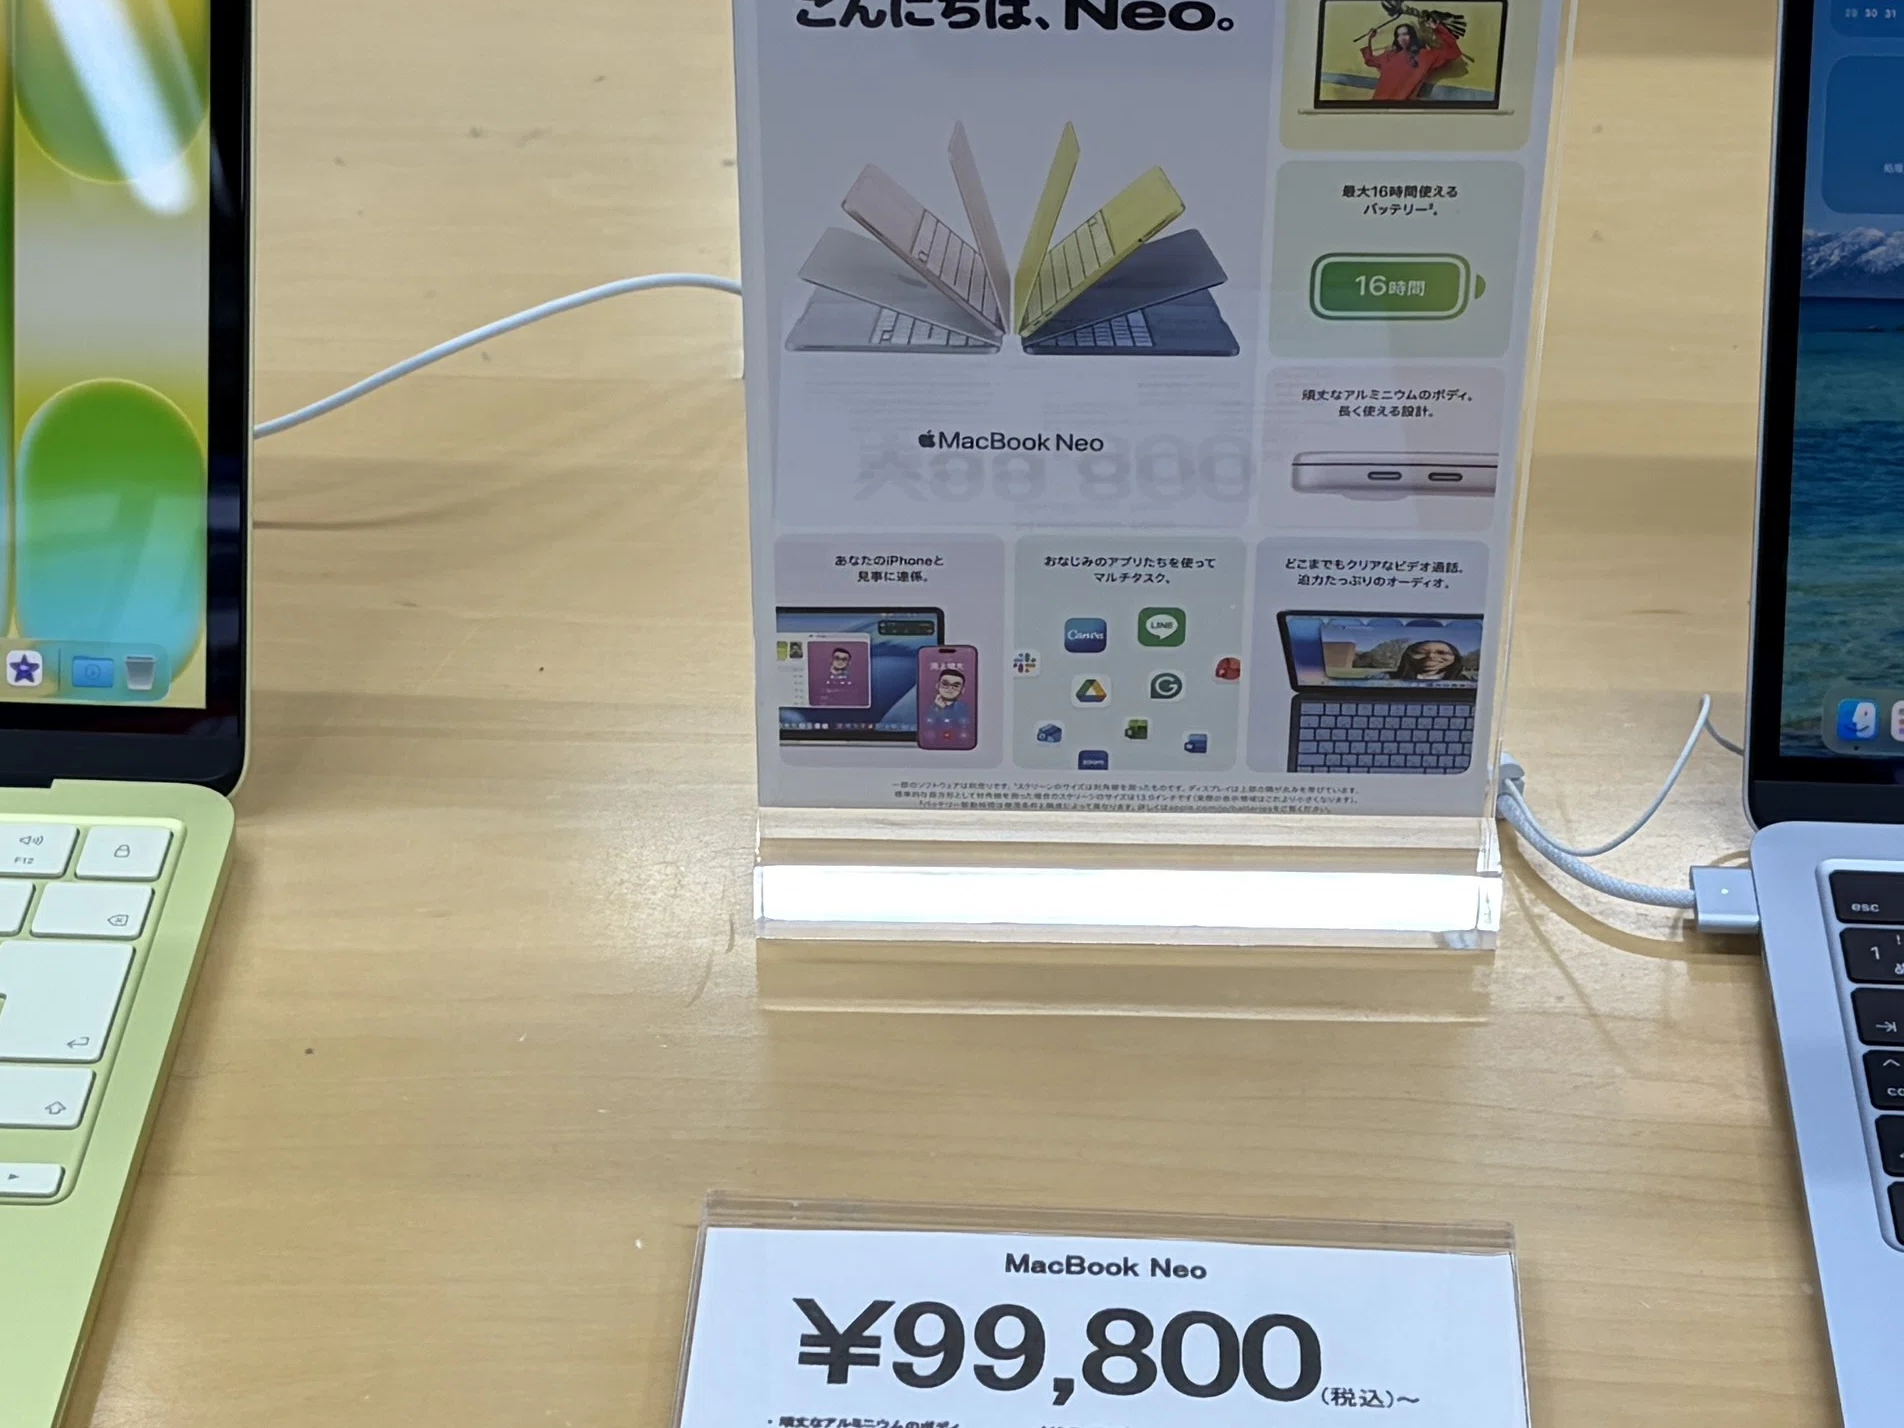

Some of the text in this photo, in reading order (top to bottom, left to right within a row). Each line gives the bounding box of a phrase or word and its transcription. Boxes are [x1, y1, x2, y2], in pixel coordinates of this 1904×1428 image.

[1341, 184, 1458, 199] 最大16時間使える
[1354, 274, 1427, 297] 16時間
[1301, 388, 1474, 402] 頑丈なアルミニウムのボディ。
[1338, 404, 1434, 418] 長く使える設計。
[938, 431, 1105, 453] MacBook Neo
[834, 554, 945, 568] あなたのiPhoneと
[1043, 555, 1216, 570] おなじみのアプリたちを使って
[1285, 557, 1464, 574] どこまでもクリアなビデオ通話。
[1093, 572, 1172, 585] マルチタスク。
[1297, 574, 1451, 589] 迫力たっぷりのオーディオ。
[1850, 901, 1881, 914] esc
[1005, 1253, 1207, 1280] MacBook Neo
